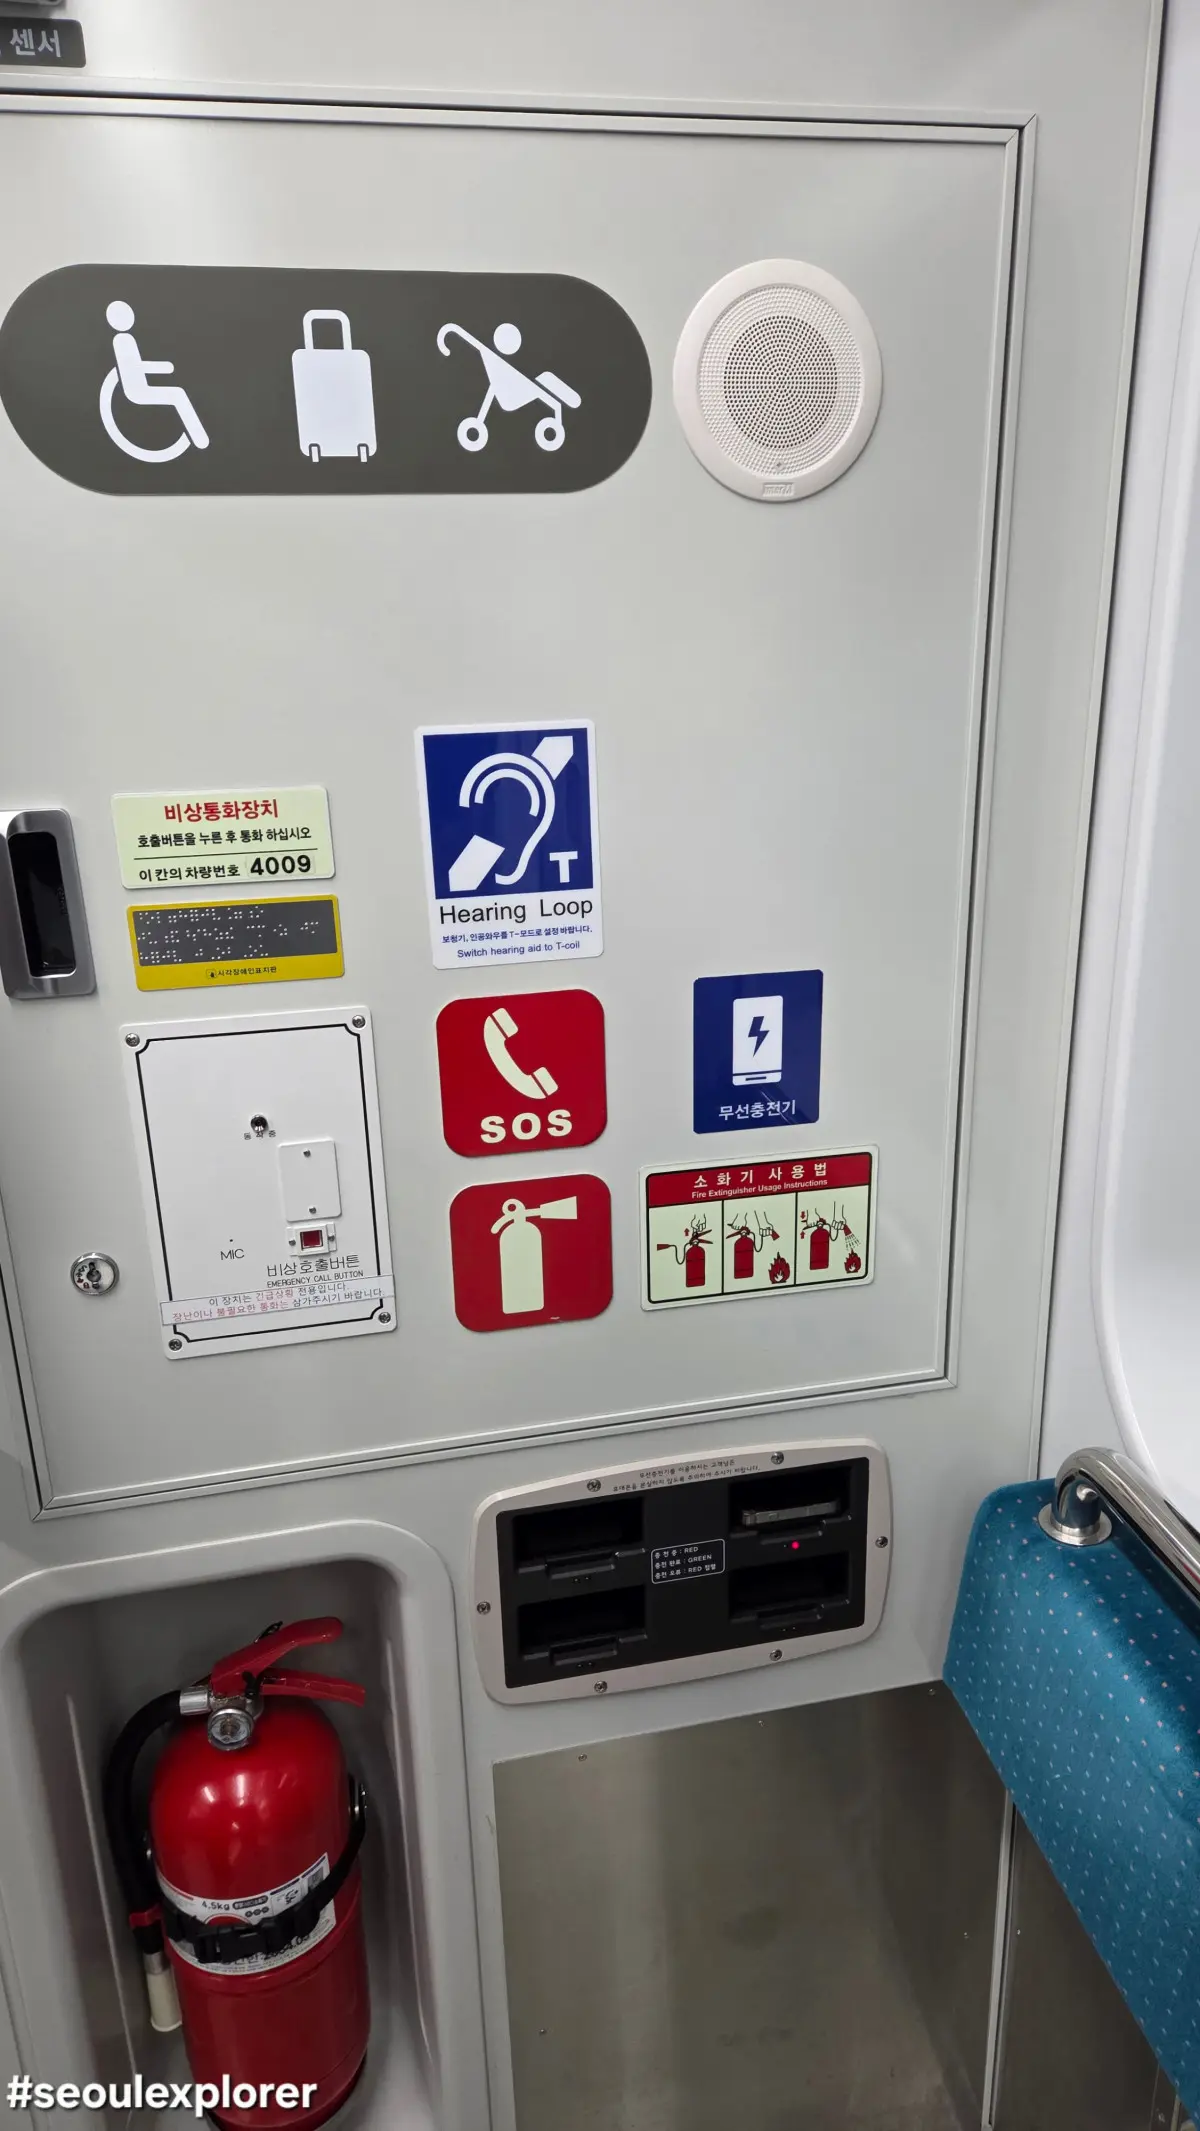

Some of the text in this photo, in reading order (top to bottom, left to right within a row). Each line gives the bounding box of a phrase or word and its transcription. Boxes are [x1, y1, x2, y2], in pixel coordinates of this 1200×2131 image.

[10, 28, 61, 58] 센서
[164, 799, 279, 822] 비상통화장치
[138, 827, 312, 848] 호출버튼을 누른 후 통화 하십시오
[139, 855, 311, 882] 이 칸의 차량번호 4009
[549, 850, 578, 883] T
[440, 899, 593, 924] Hearing Loop
[457, 941, 580, 958] Switch hearing aid to T-coil
[718, 1099, 796, 1120] 무선충전기
[480, 1108, 572, 1143] SOS
[691, 1179, 828, 1199] Fire Extinguisher Usage Instructions
[220, 1248, 245, 1260] MIC
[267, 1254, 360, 1277] 비상호출버튼
[267, 1270, 364, 1288] EMERGENCY CALL BUTTON
[209, 1297, 219, 1307] 이
[222, 1294, 252, 1306] 장치는
[687, 1554, 712, 1563] GREEN
[201, 1900, 230, 1911] 4.5kg
